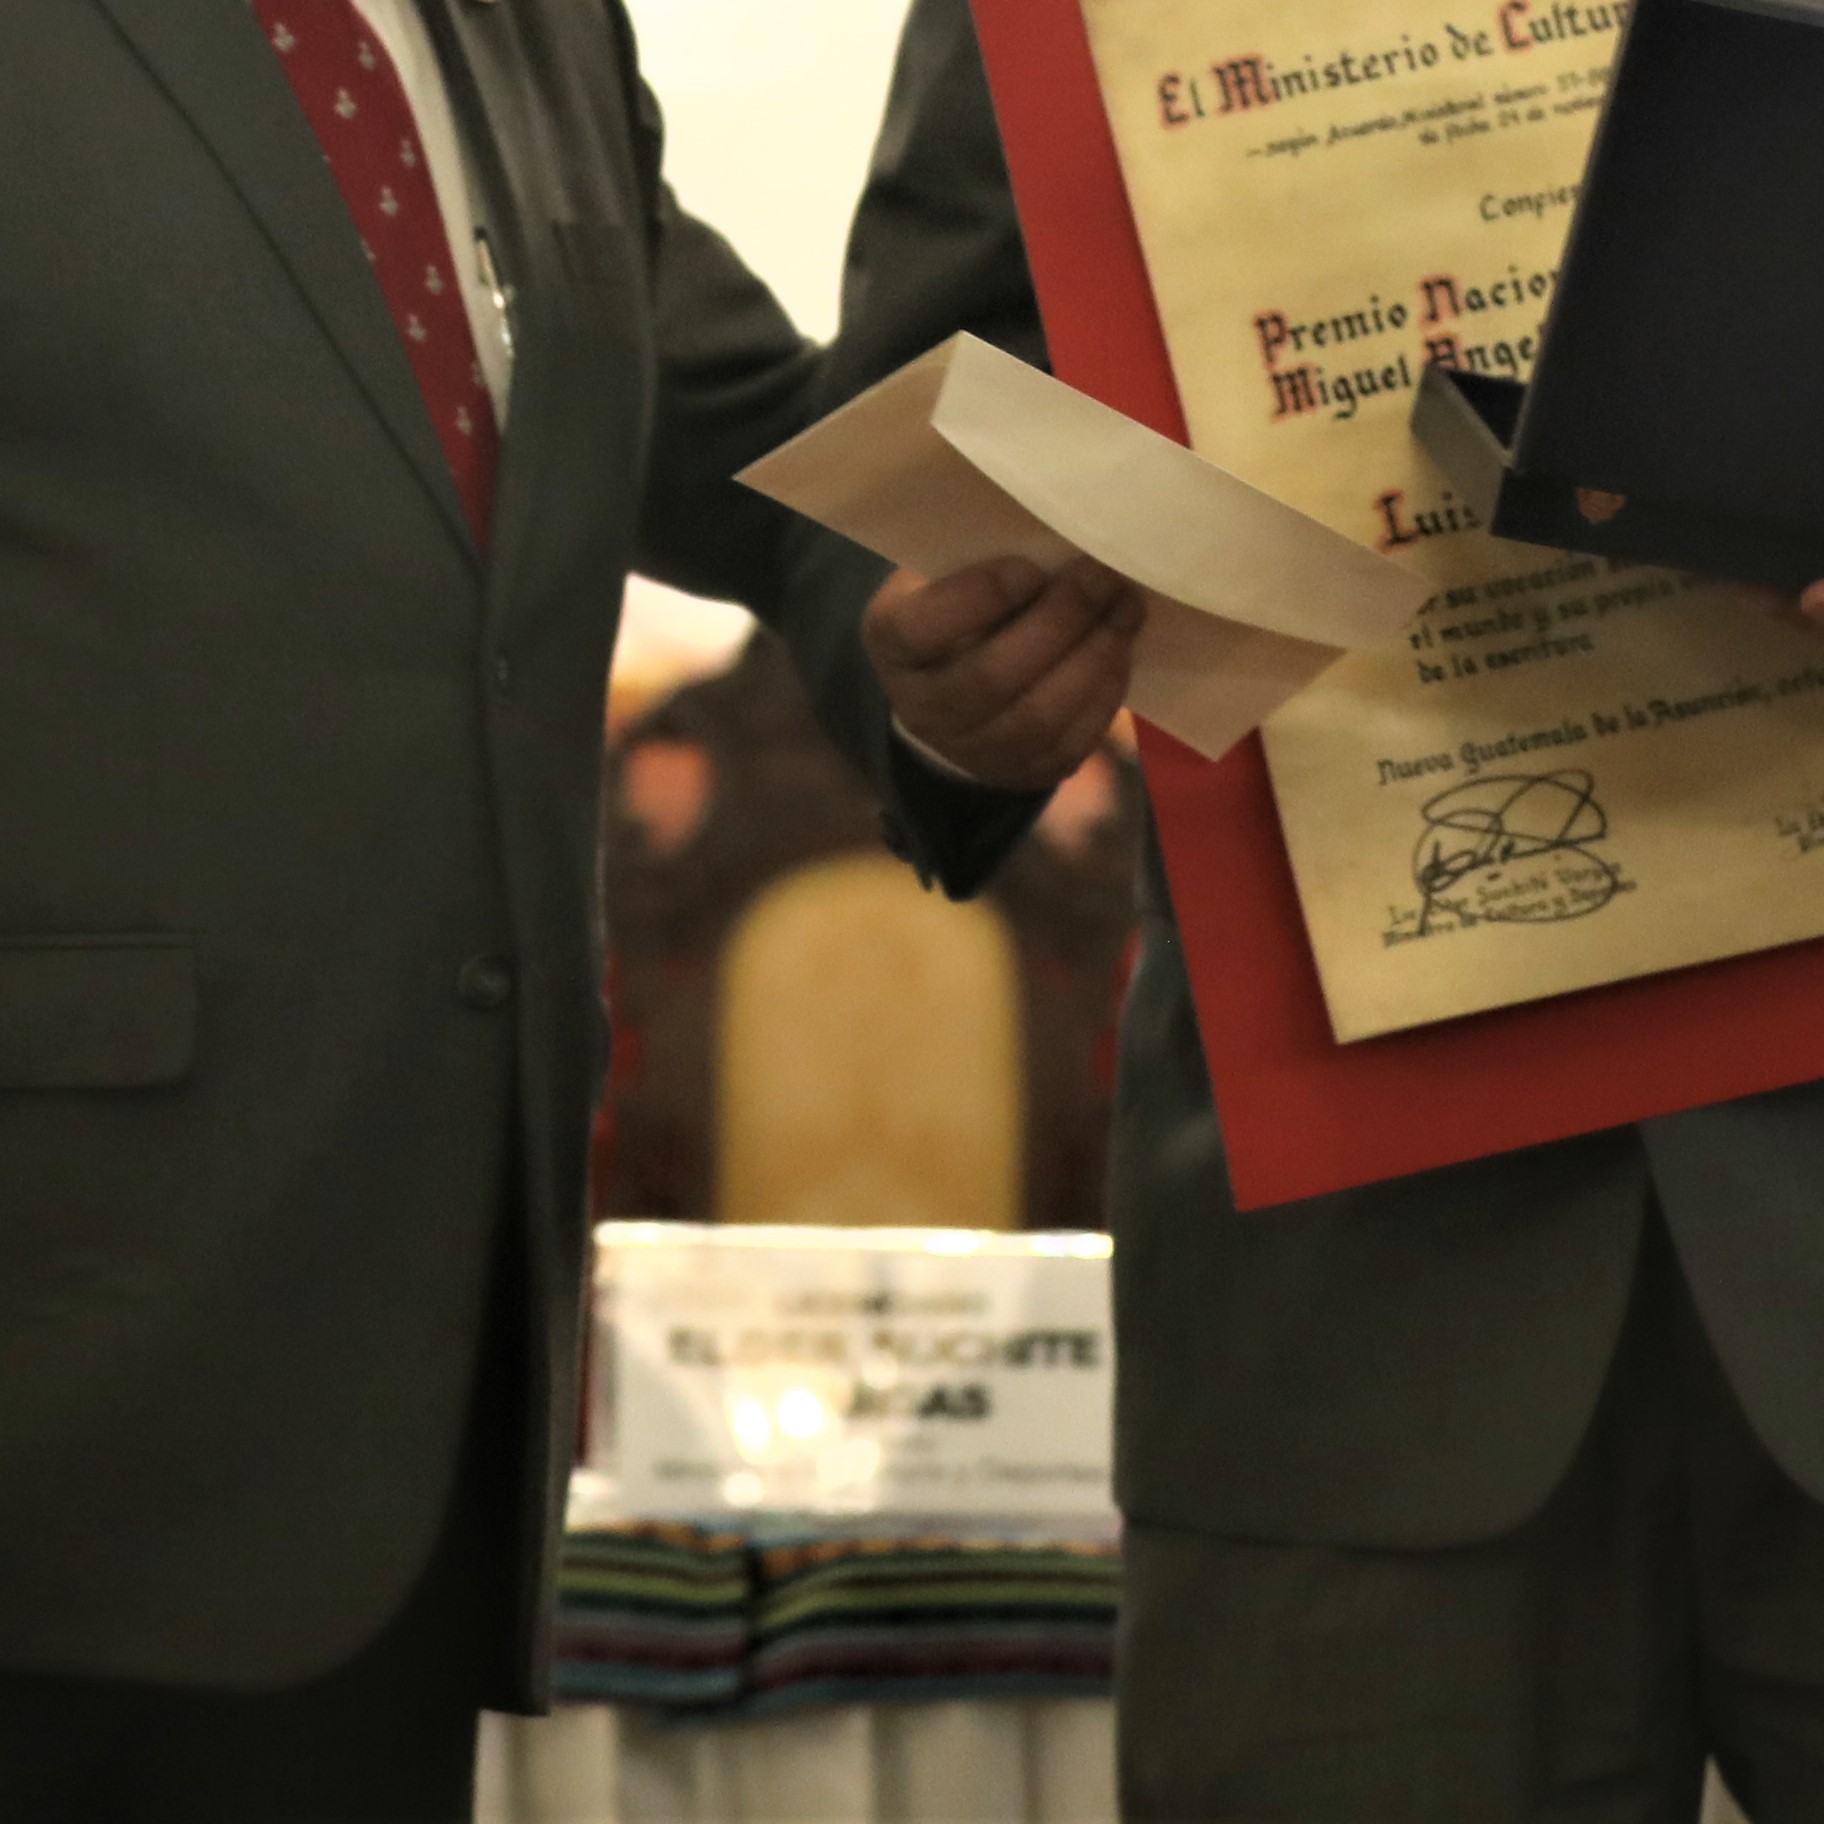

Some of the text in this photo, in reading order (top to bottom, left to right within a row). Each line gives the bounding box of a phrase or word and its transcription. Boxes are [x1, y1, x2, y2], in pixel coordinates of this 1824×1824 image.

[1156, 73, 1205, 129] El
[1214, 36, 1441, 114] Ministerio
[1445, 22, 1494, 61] de
[1256, 295, 1409, 366] Premio
[1272, 354, 1412, 420] Miguel
[1376, 490, 1479, 547] Luis
